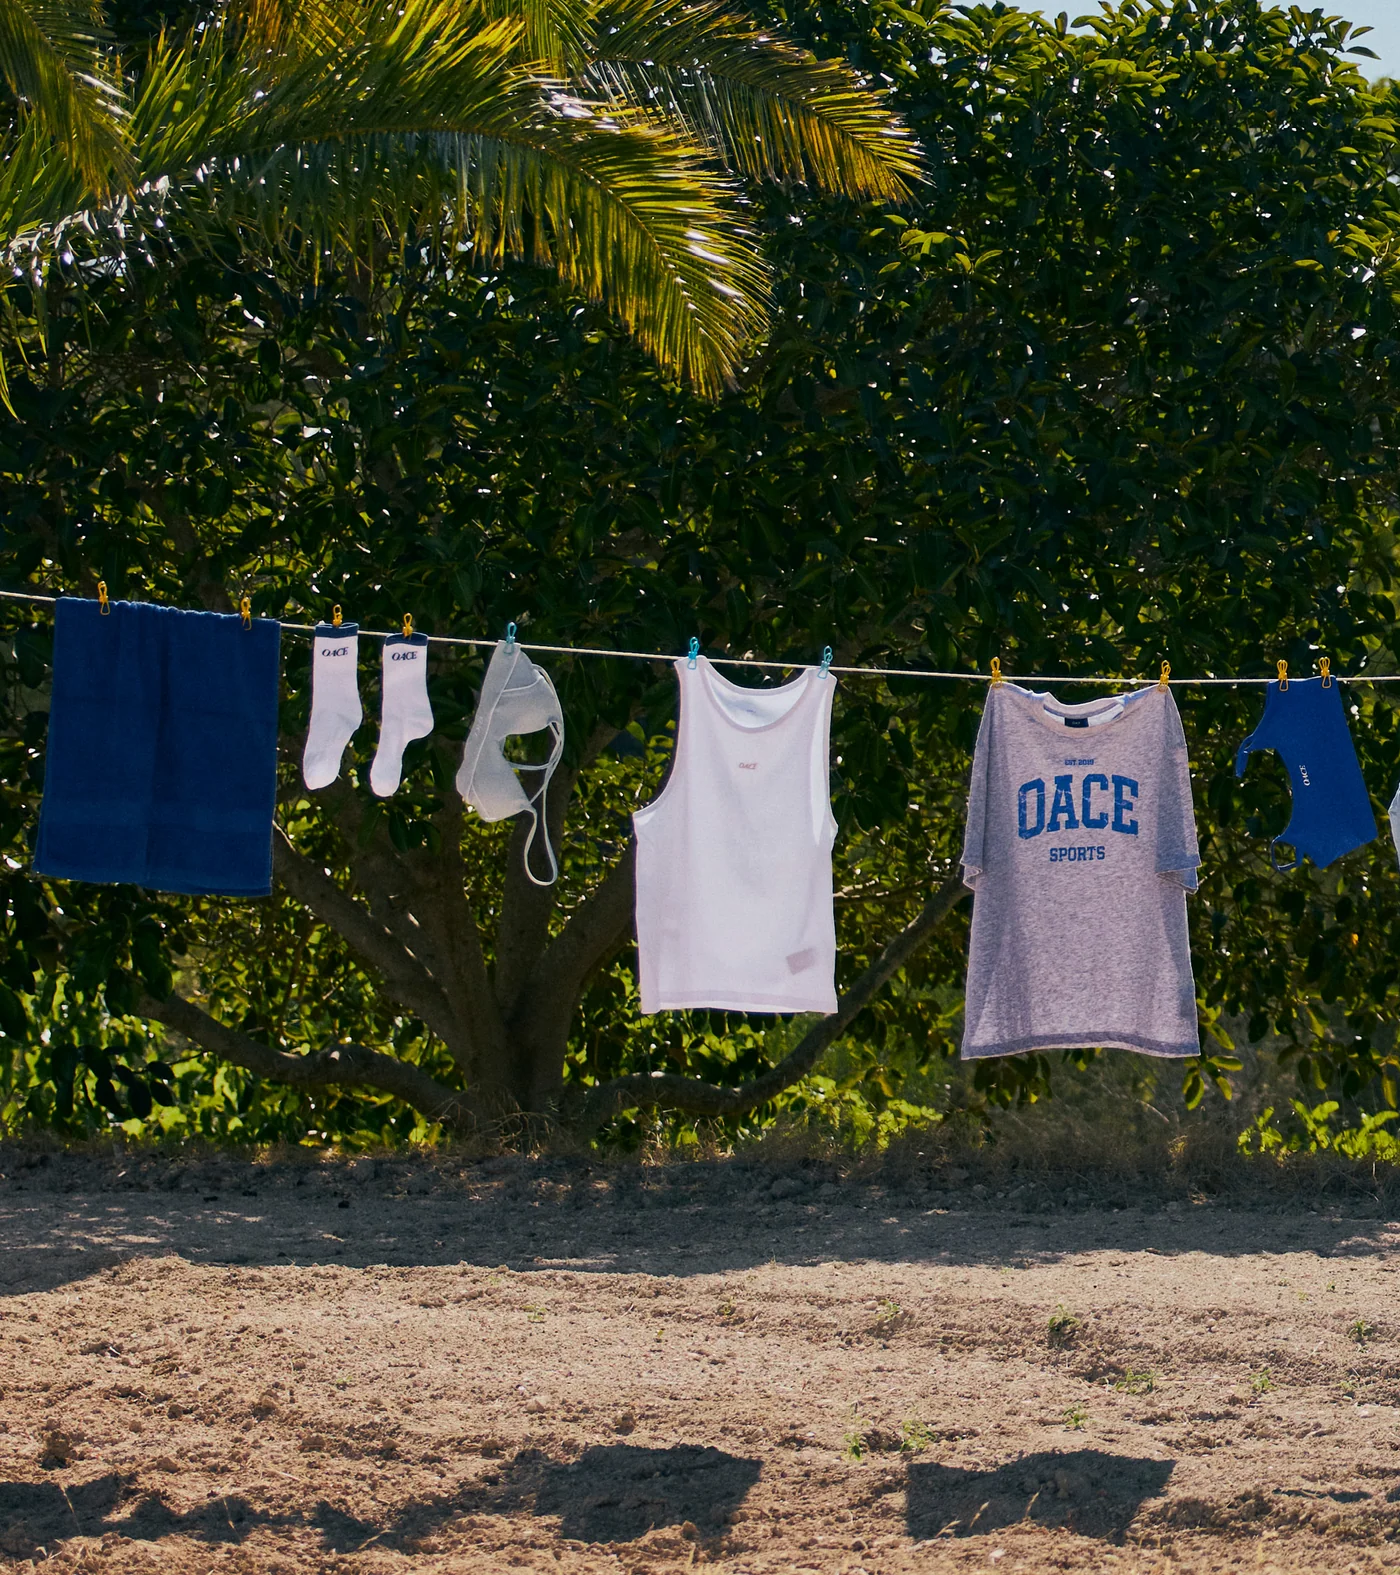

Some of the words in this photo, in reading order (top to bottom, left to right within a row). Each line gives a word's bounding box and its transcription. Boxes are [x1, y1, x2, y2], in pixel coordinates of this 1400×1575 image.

[321, 647, 349, 657] OACE
[391, 651, 418, 661] OACE
[1298, 764, 1311, 786] OACE
[1018, 773, 1139, 840] OACE
[1049, 846, 1105, 862] SPORTS
